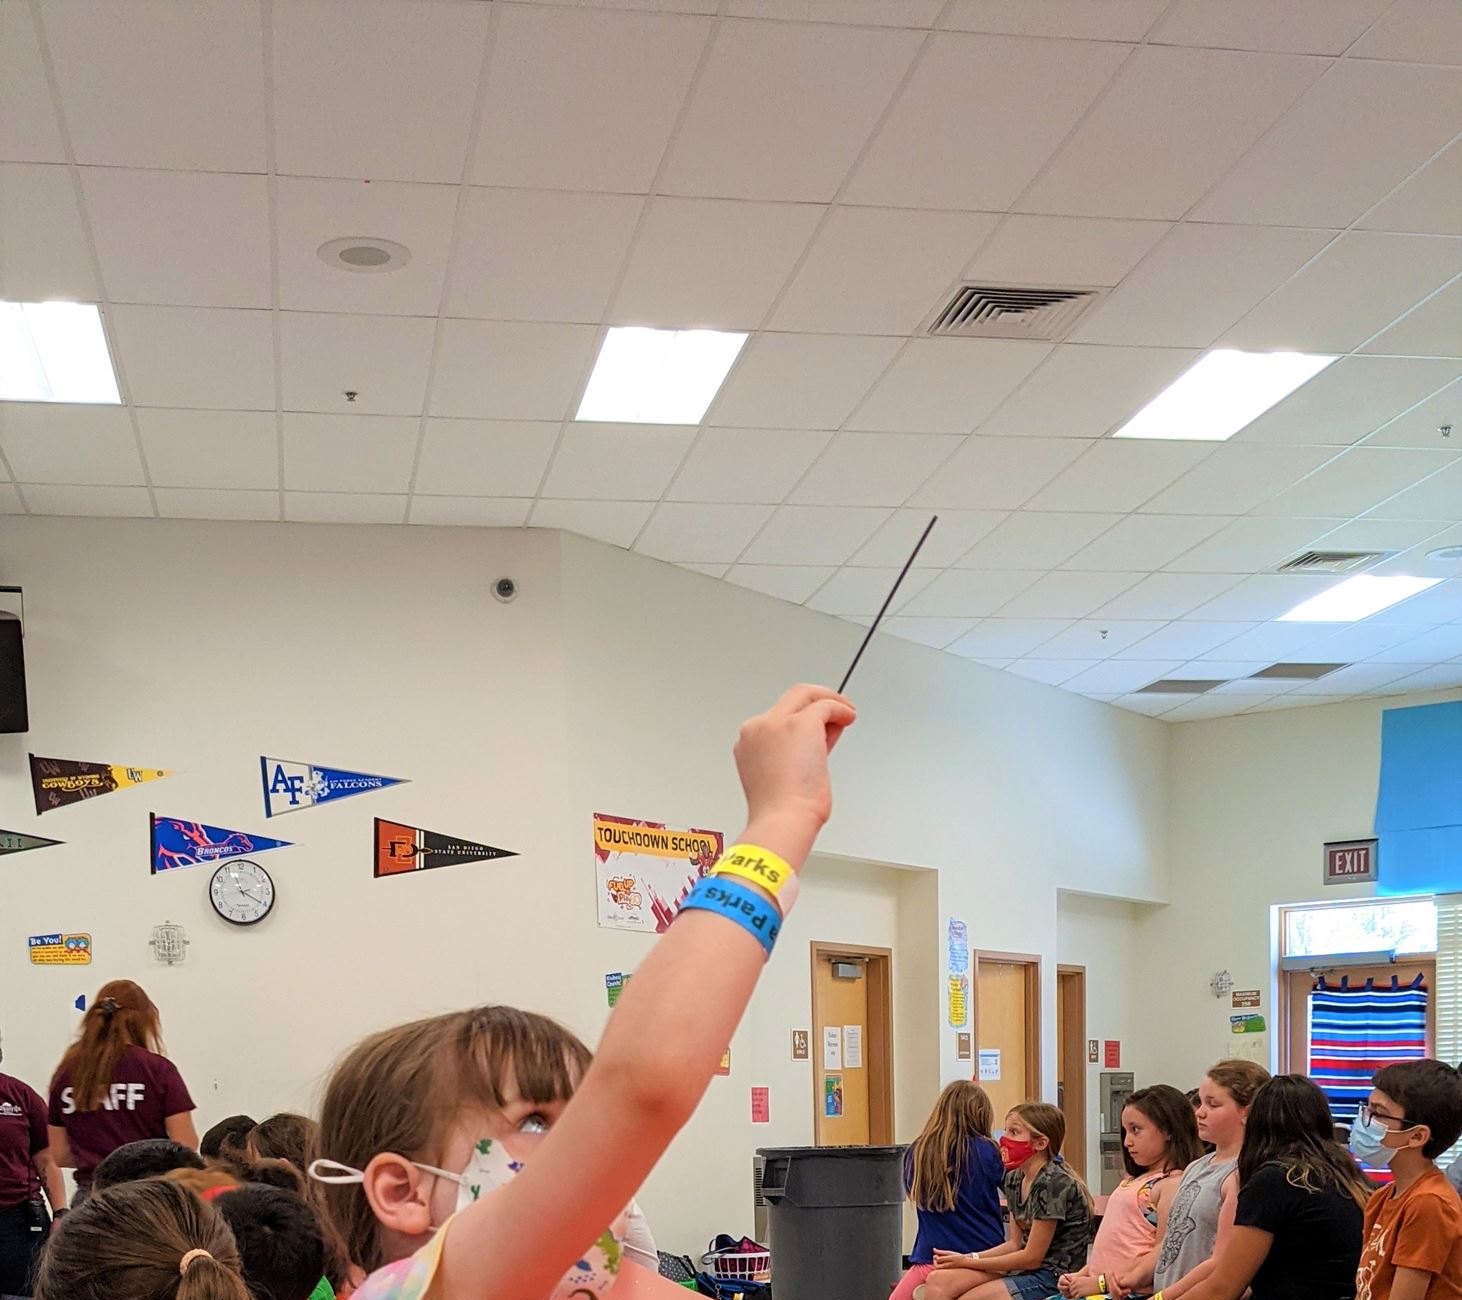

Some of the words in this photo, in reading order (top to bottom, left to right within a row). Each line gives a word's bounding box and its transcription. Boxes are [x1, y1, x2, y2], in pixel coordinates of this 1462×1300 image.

[330, 781, 382, 789] FALCONS
[197, 846, 233, 856] BRONCOS
[597, 827, 669, 850] TOUCHDOWN
[671, 836, 713, 854] SCHOOL
[729, 853, 781, 883] arks
[1335, 850, 1367, 874] EXIT
[43, 935, 62, 944] You!
[61, 1083, 145, 1114] SFF
